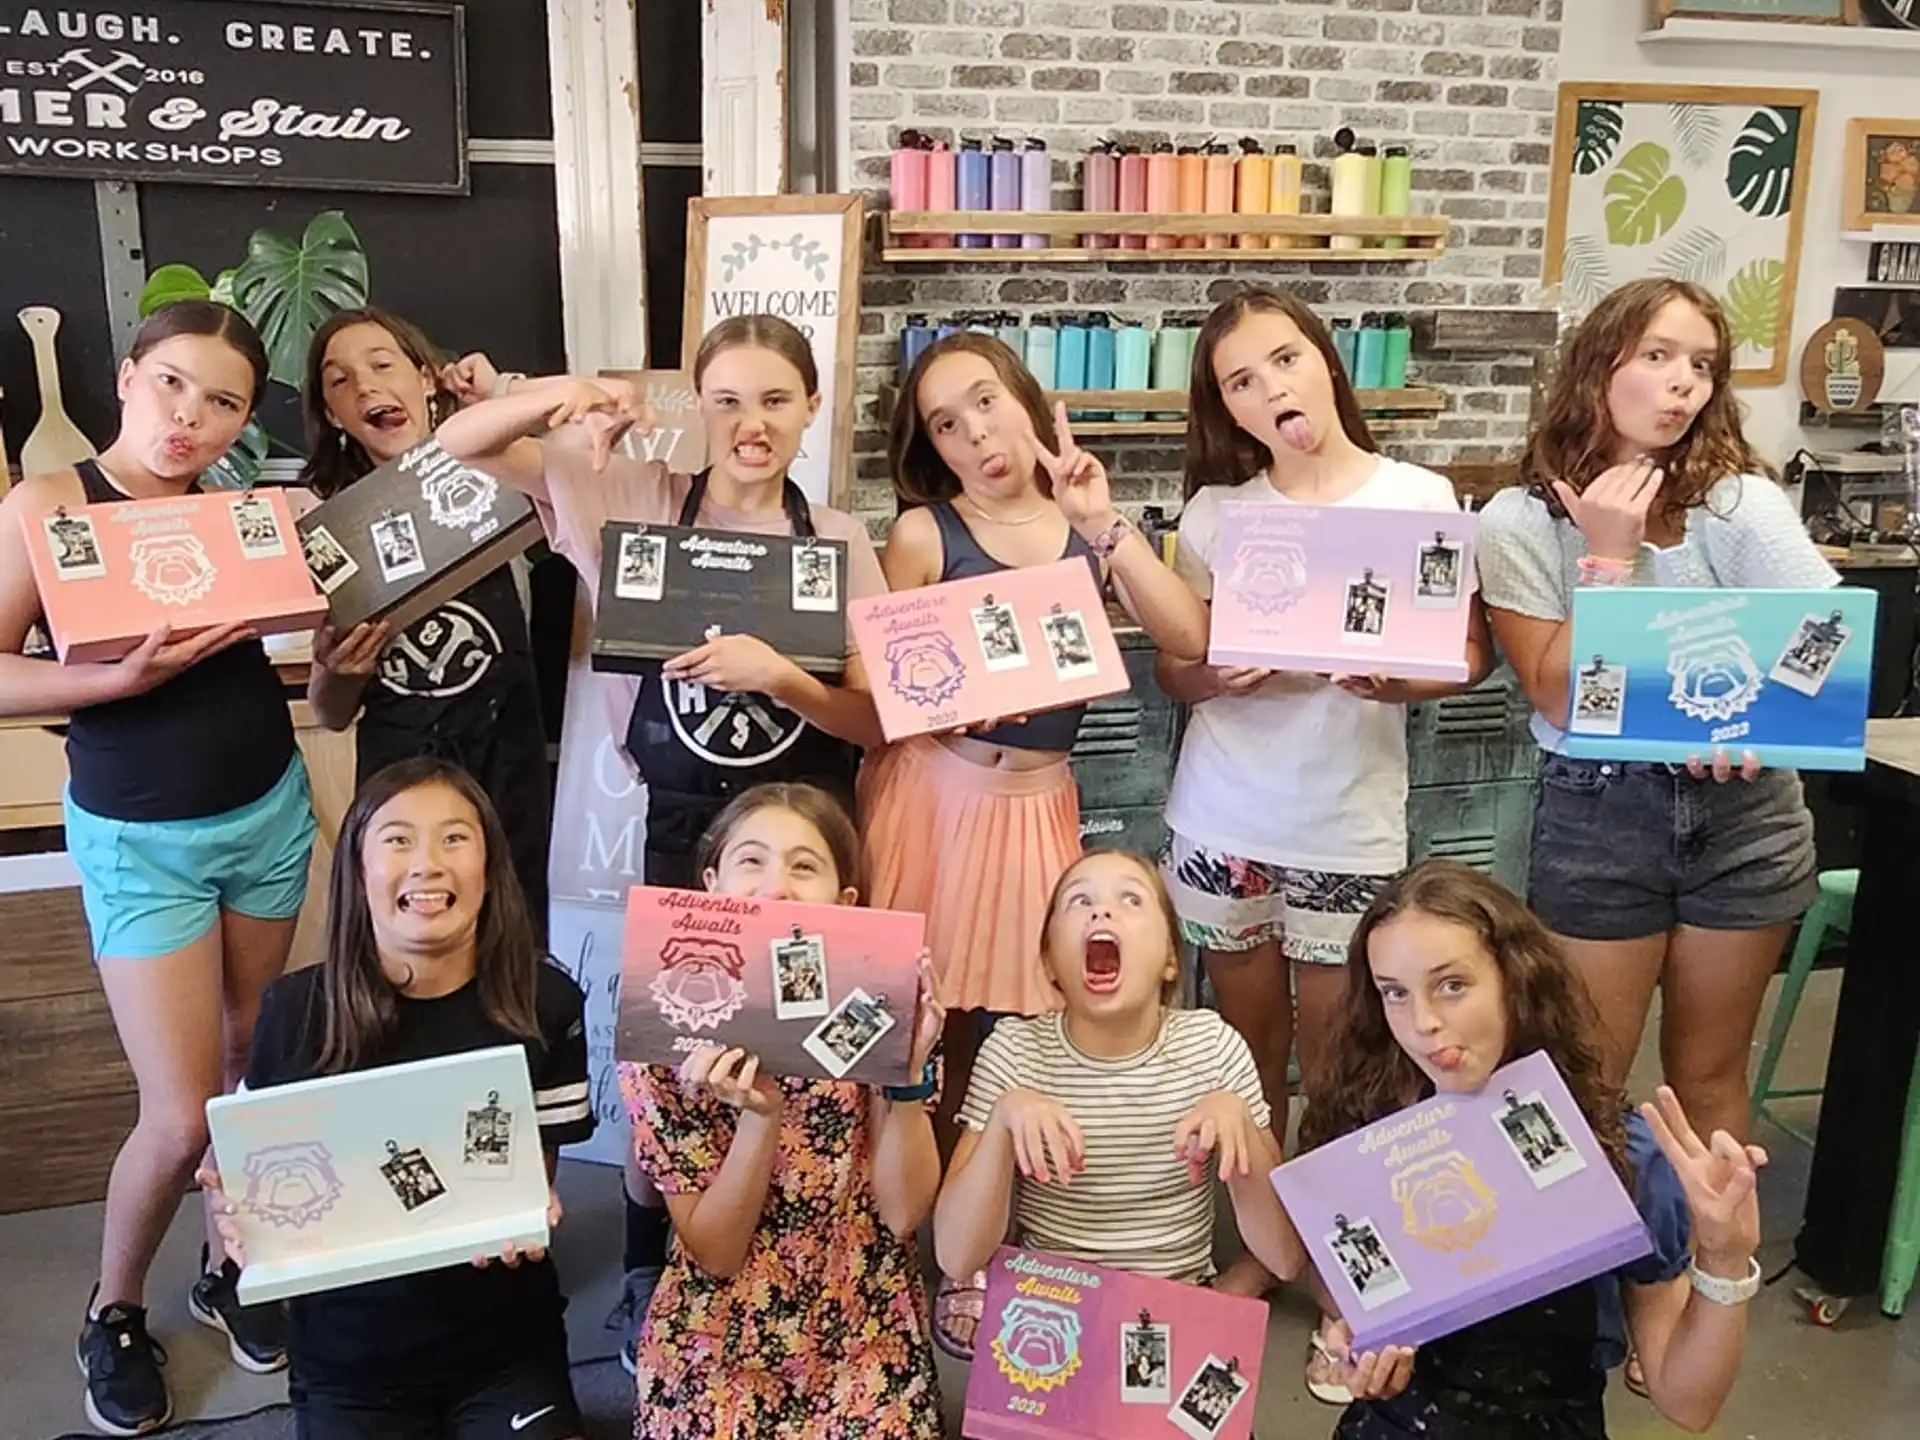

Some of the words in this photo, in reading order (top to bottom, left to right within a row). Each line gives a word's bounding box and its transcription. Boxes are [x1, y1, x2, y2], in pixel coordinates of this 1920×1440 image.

[226, 21, 432, 59] CREATE.
[145, 69, 205, 85] 2016
[149, 97, 206, 131] &
[218, 98, 412, 142] Stain
[7, 136, 283, 166] WORKSHOPS
[710, 290, 837, 318] WELCOME
[679, 534, 768, 557] Adventure
[691, 552, 754, 572] Awaits
[865, 596, 947, 621] Adventure
[883, 612, 940, 635] Awaits
[658, 891, 762, 916] Adventure
[672, 911, 742, 935] Awaits
[1357, 1103, 1457, 1154] Adventure
[1383, 1129, 1453, 1169] Awaits
[1003, 1252, 1102, 1289] Adventure
[1014, 1275, 1083, 1305] Awaits
